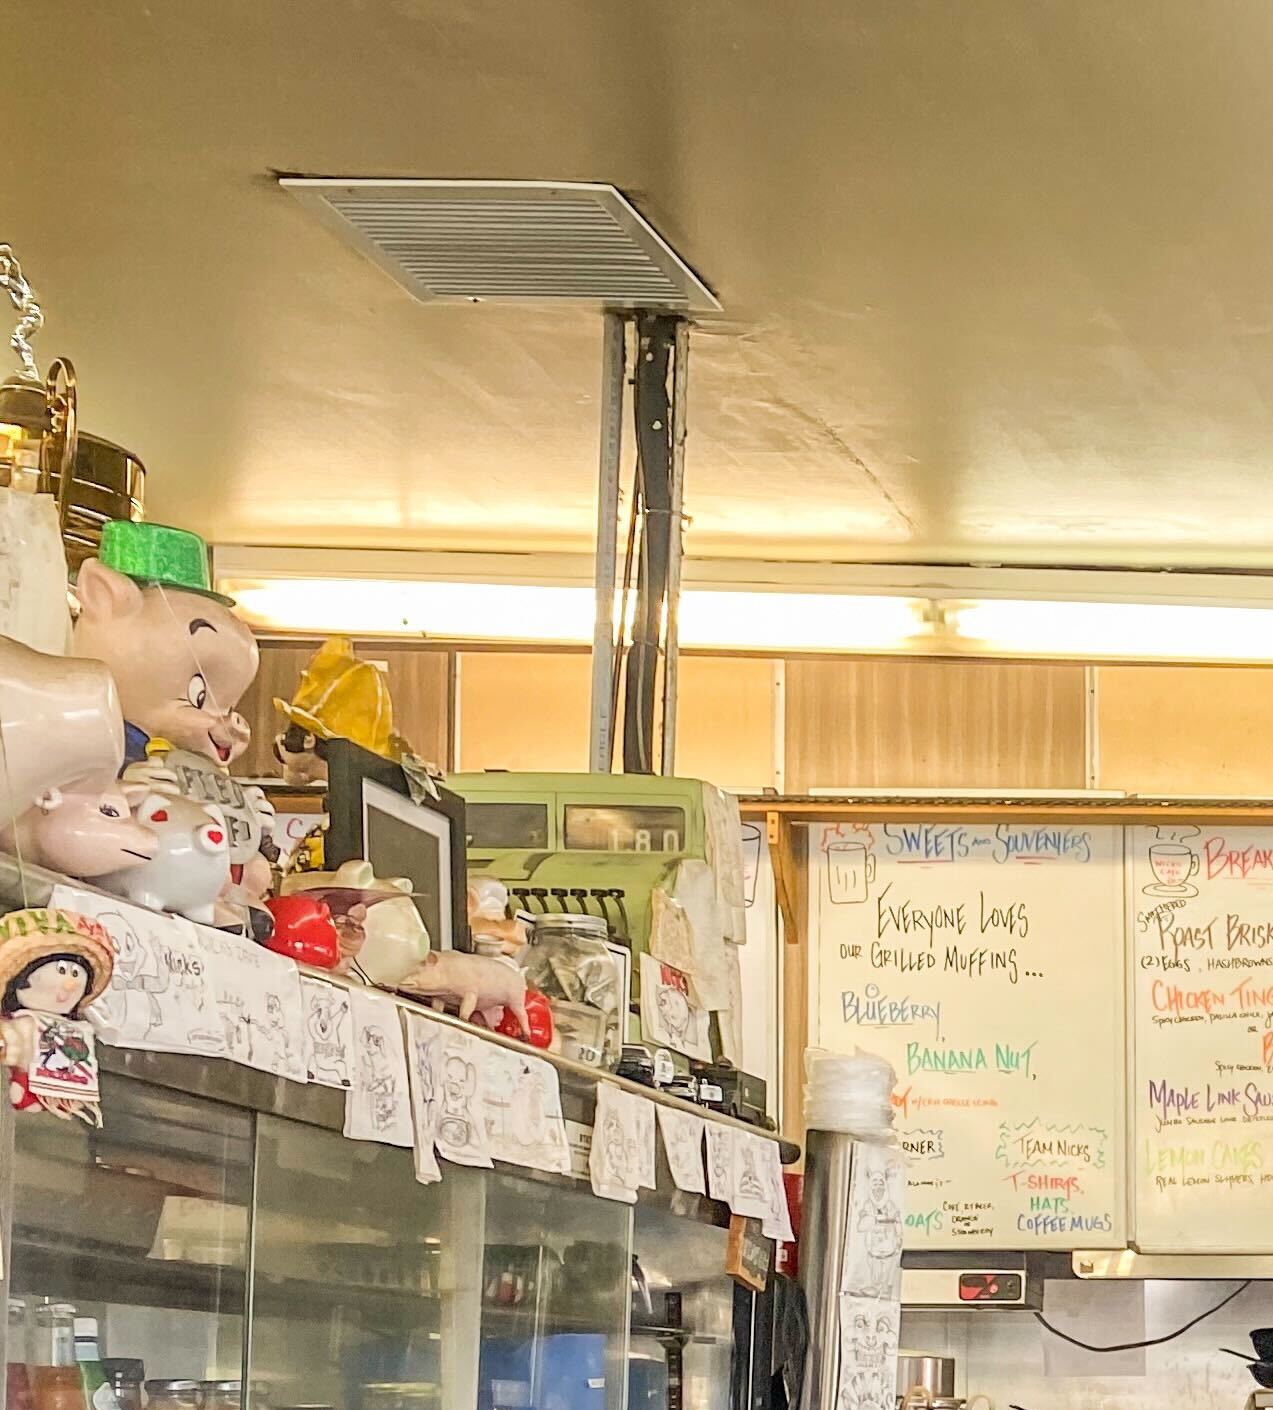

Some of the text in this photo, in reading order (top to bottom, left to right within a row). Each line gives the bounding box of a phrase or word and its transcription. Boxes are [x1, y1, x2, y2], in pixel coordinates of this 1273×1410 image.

[884, 823, 968, 862] SWEETS
[877, 882, 1029, 948] EVERYONE LOVES
[1155, 909, 1219, 962] ROAST
[839, 943, 863, 960] OUR
[870, 941, 936, 974] GRILLED
[1152, 979, 1225, 1016] CHICKEN
[907, 1041, 988, 1076] BANANA
[1149, 1078, 1202, 1119] MAPLE
[1206, 1083, 1242, 1112] LINK
[1014, 1132, 1091, 1162] TEAM NICKS
[1144, 1137, 1206, 1175] LEMON
[1017, 1214, 1113, 1236] COFFEE MUGS
